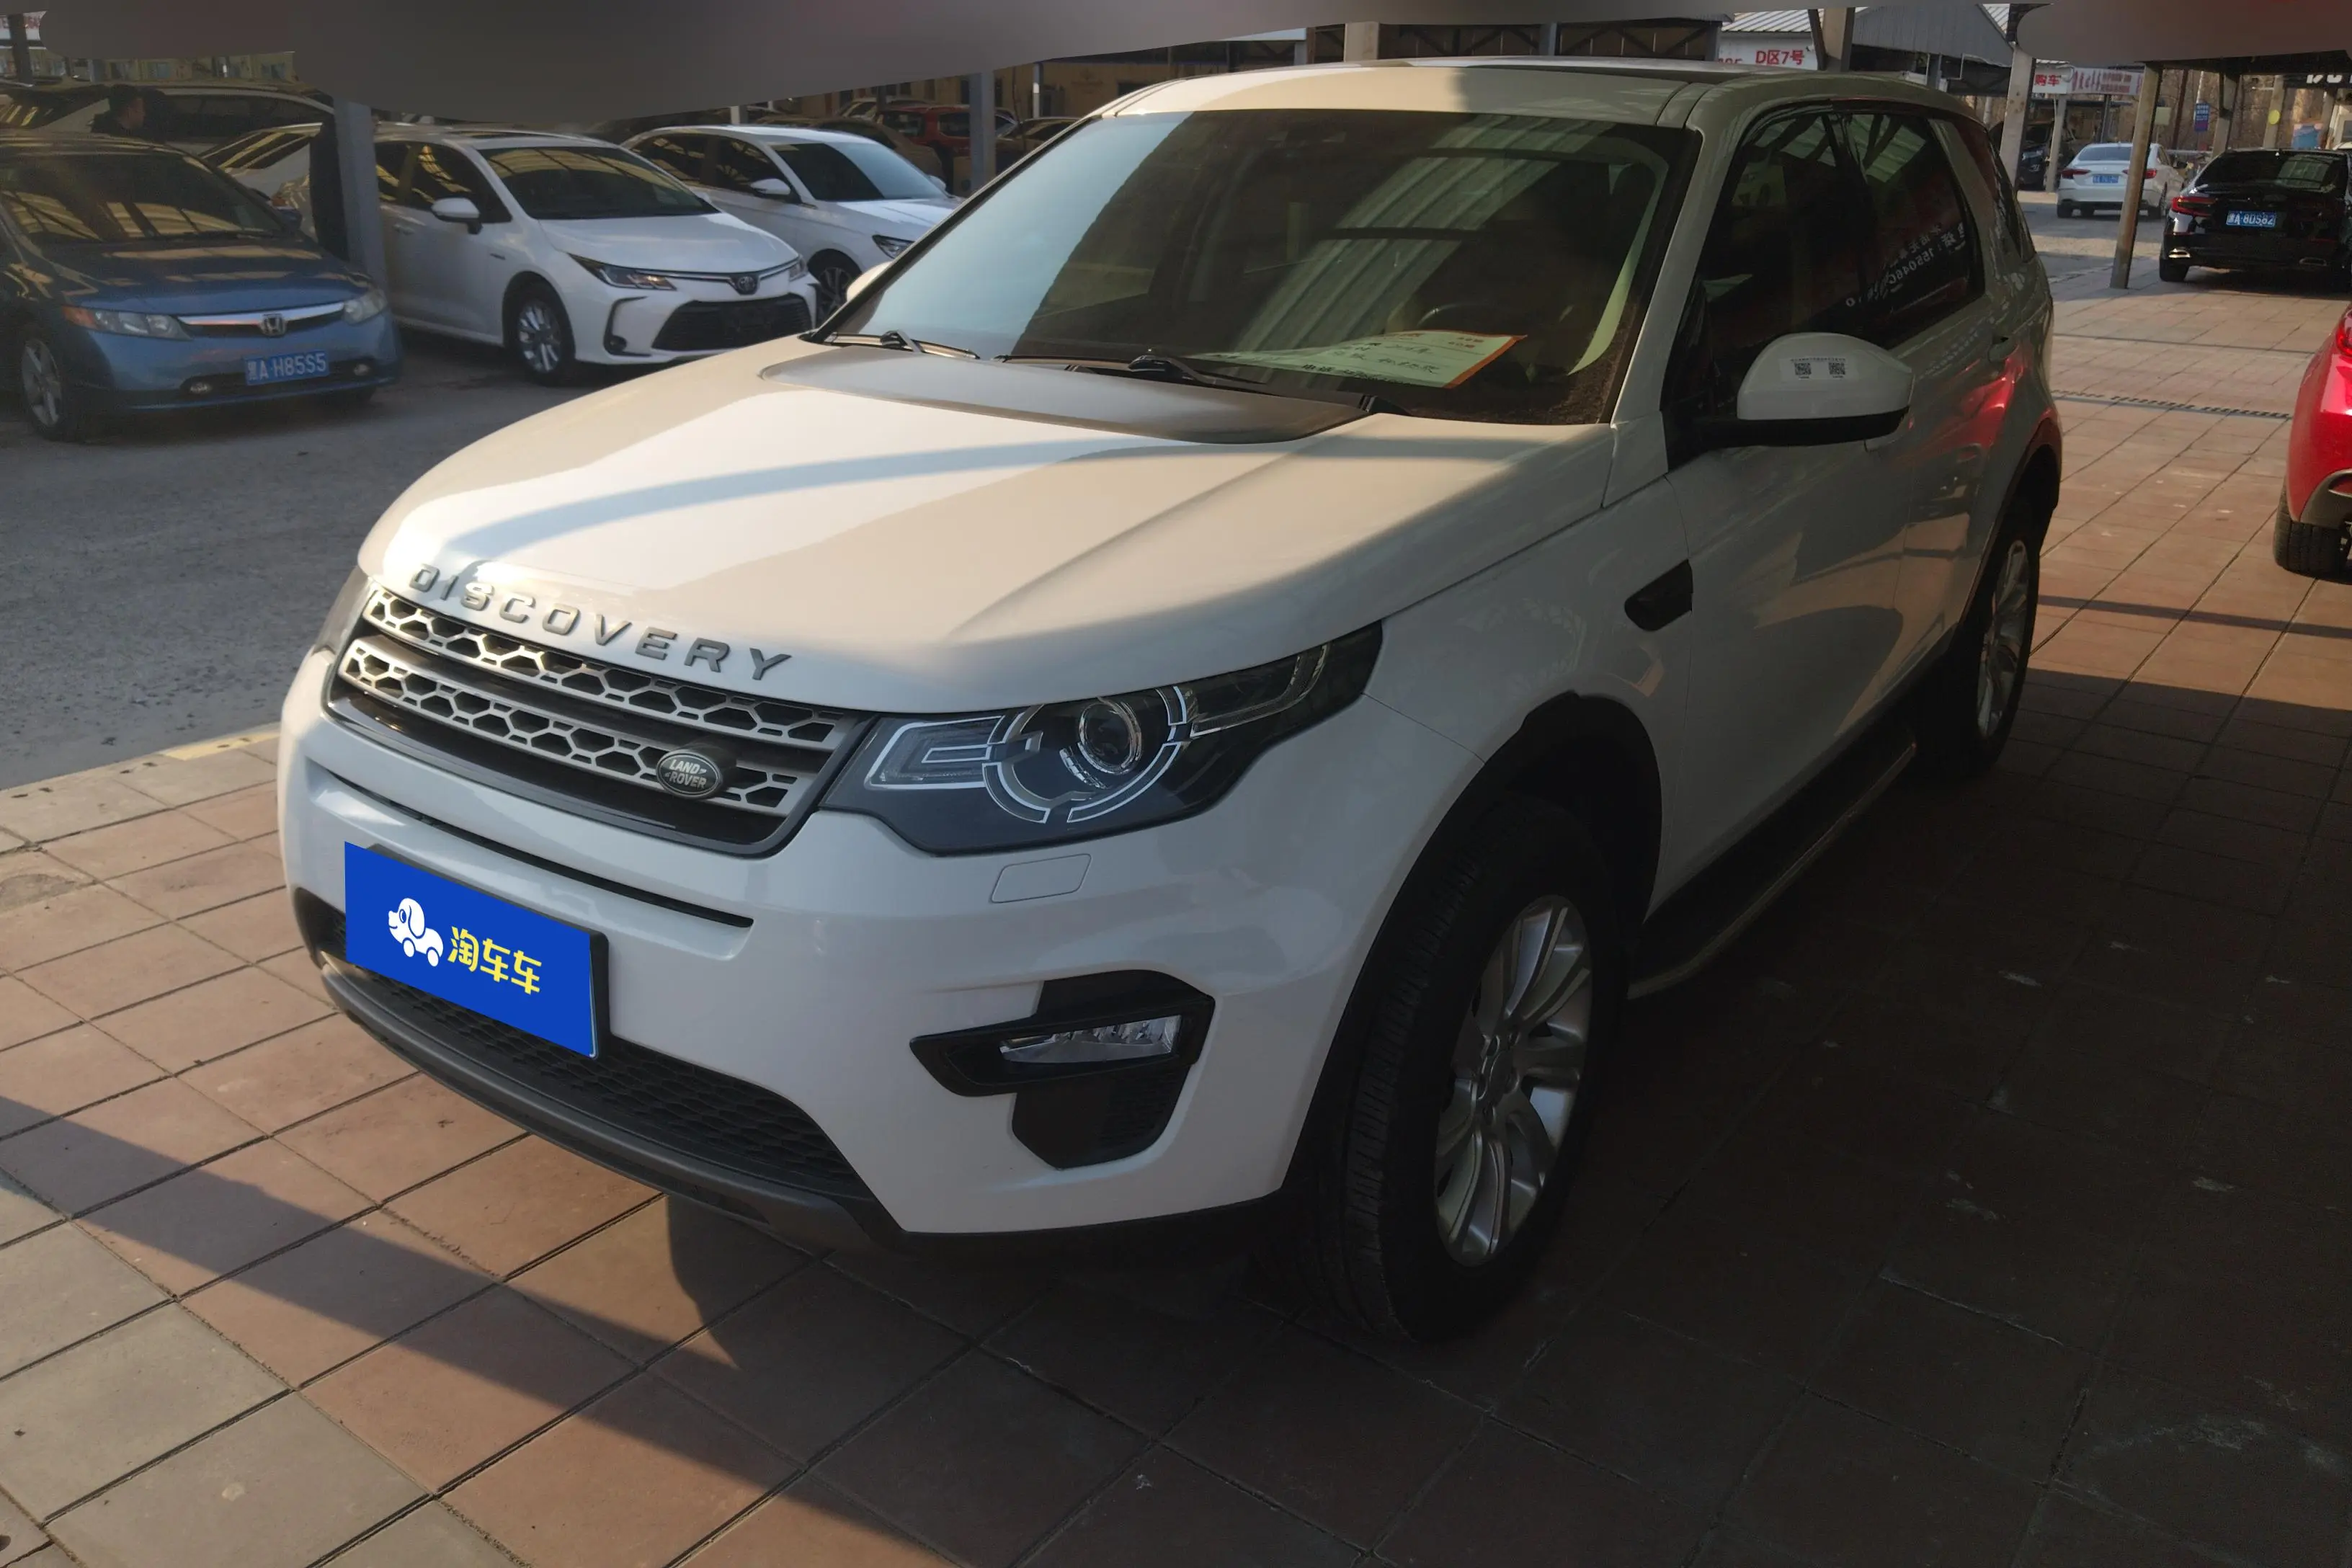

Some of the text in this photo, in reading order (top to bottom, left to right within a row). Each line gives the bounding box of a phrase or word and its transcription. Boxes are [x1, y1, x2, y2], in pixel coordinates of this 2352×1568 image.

[1756, 50, 1805, 66] D区7号
[409, 564, 791, 680] DISCOVERY
[669, 759, 700, 774] LAND
[669, 771, 707, 789] ROVER
